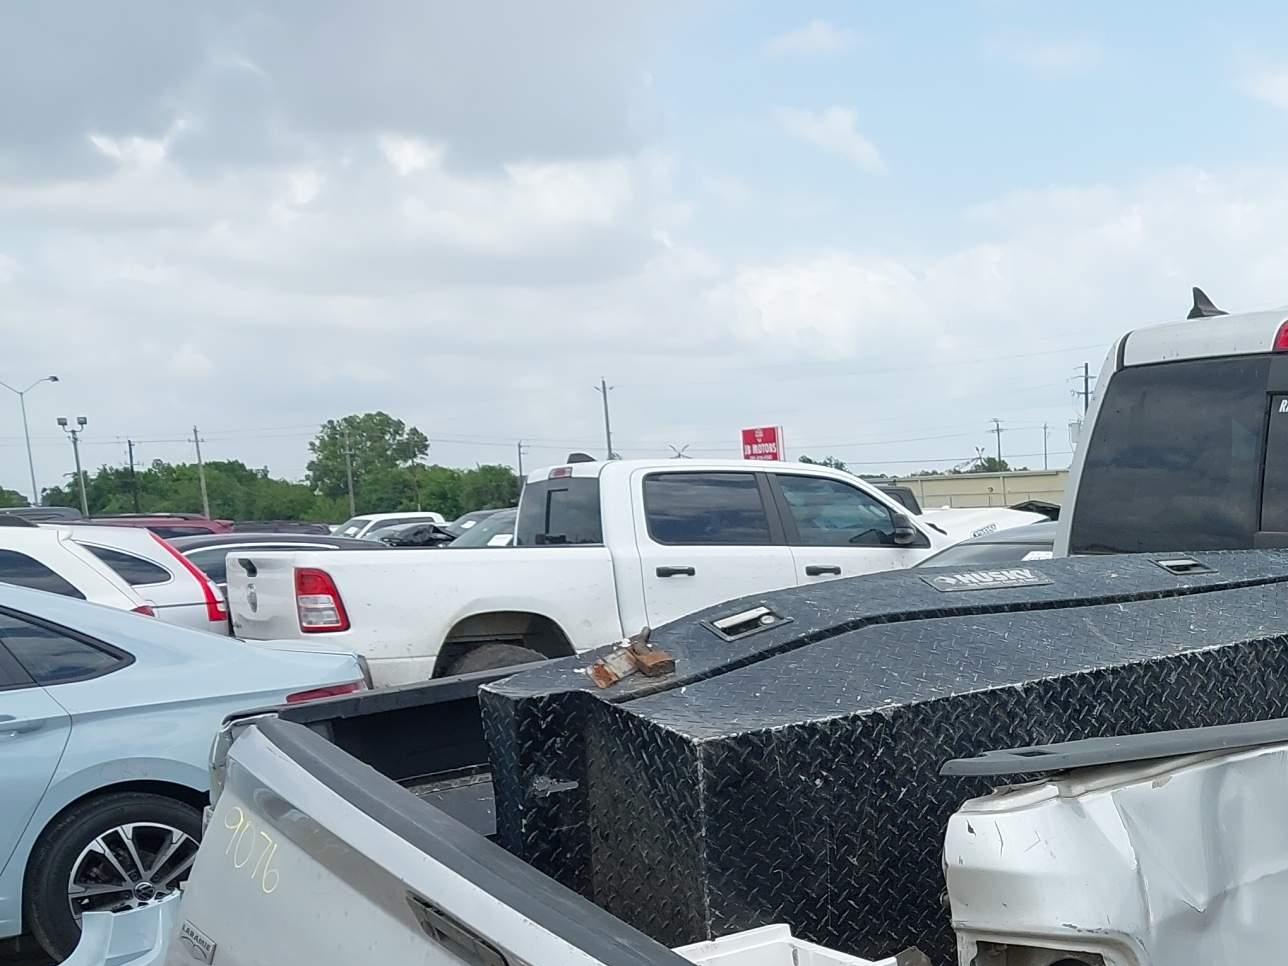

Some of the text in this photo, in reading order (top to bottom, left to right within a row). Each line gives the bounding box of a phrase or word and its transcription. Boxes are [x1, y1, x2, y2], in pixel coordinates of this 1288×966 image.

[752, 442, 777, 454] MOTORS
[953, 568, 1034, 583] HUSKY
[224, 806, 280, 894] 9076
[182, 923, 212, 952] LARAMIE
